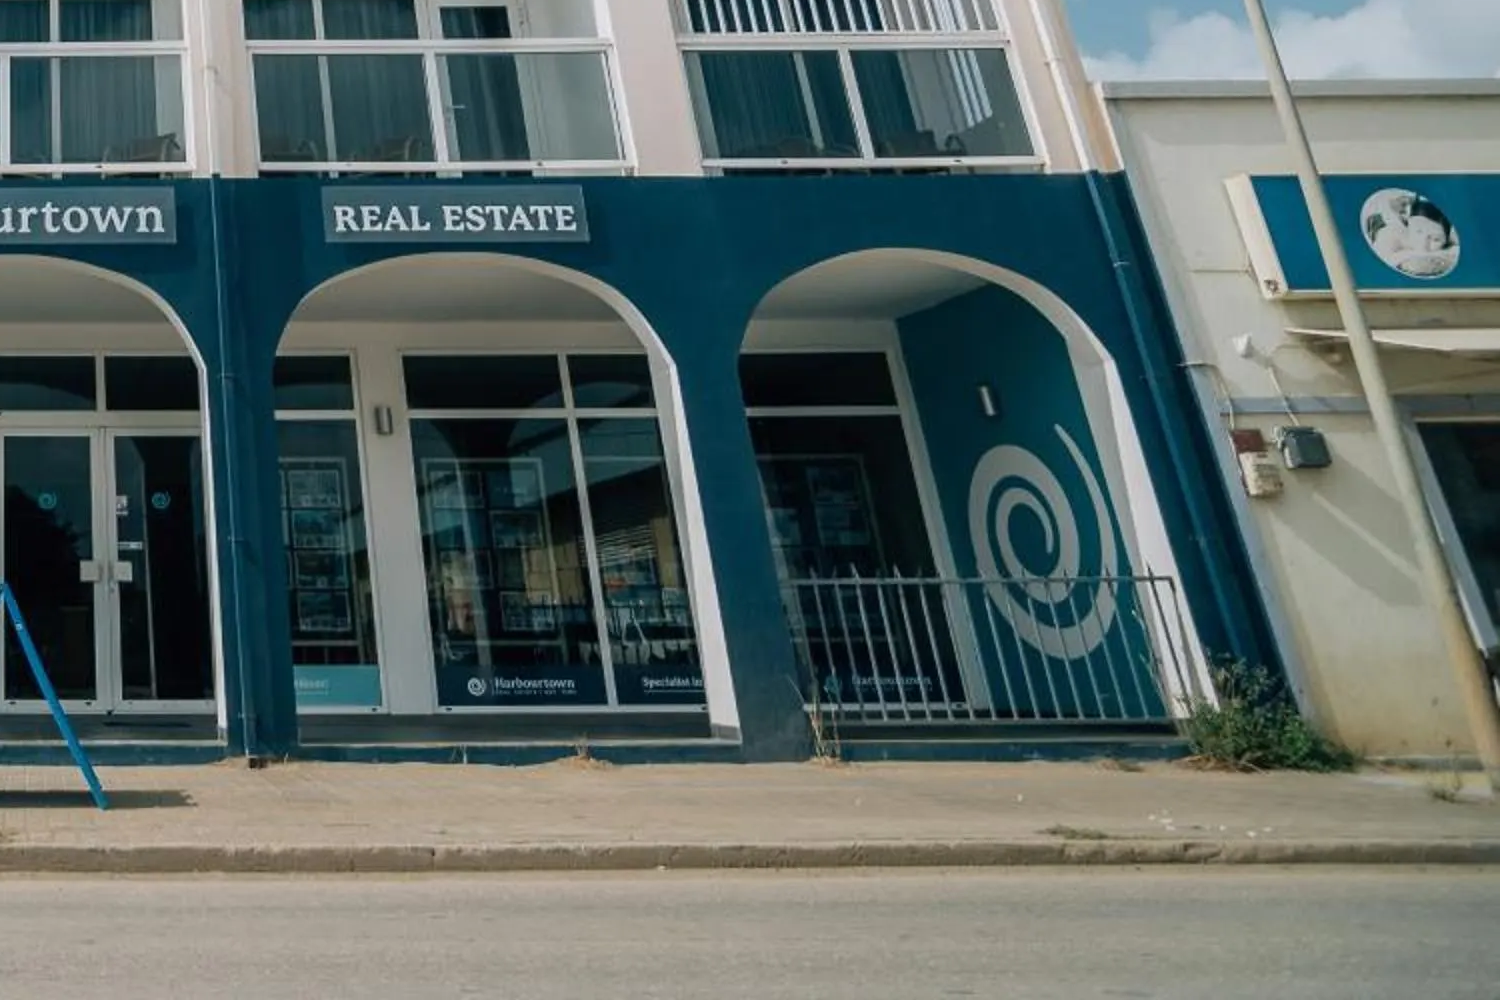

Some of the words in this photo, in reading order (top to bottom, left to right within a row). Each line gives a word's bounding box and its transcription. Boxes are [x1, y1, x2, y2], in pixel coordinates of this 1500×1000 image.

[333, 204, 431, 233] REAL
[442, 204, 578, 233] ESTATE
[494, 677, 575, 689] Harbourtown
